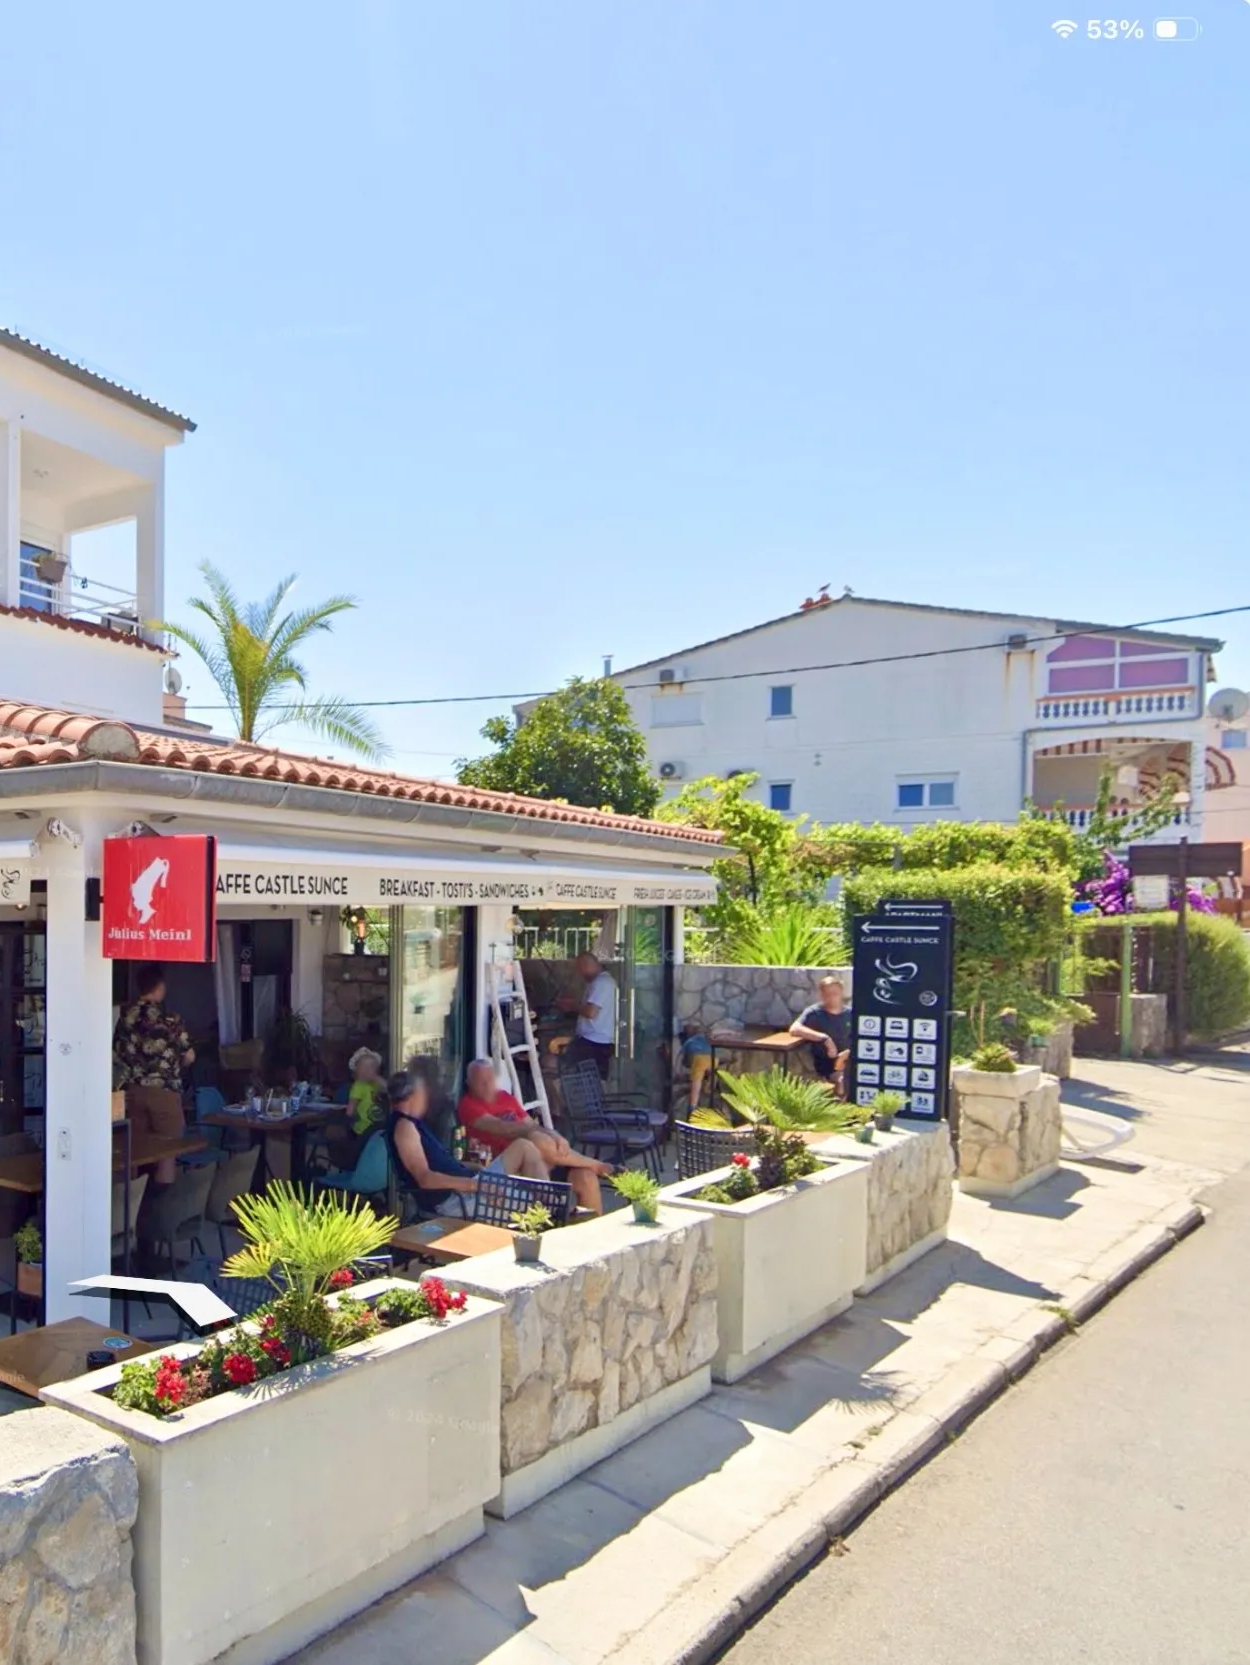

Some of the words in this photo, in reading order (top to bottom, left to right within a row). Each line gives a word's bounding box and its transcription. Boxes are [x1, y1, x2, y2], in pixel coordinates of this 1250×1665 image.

[215, 873, 251, 894] AFFE
[255, 874, 305, 894] CASTLE
[307, 876, 348, 895] SUNCE
[379, 878, 435, 897] BREAKFAST
[441, 882, 473, 898] TOSTI'S
[479, 883, 529, 898] SANDWICHES
[555, 883, 575, 897] CAFFE
[108, 927, 145, 940] Julius
[148, 928, 192, 941] Meinl
